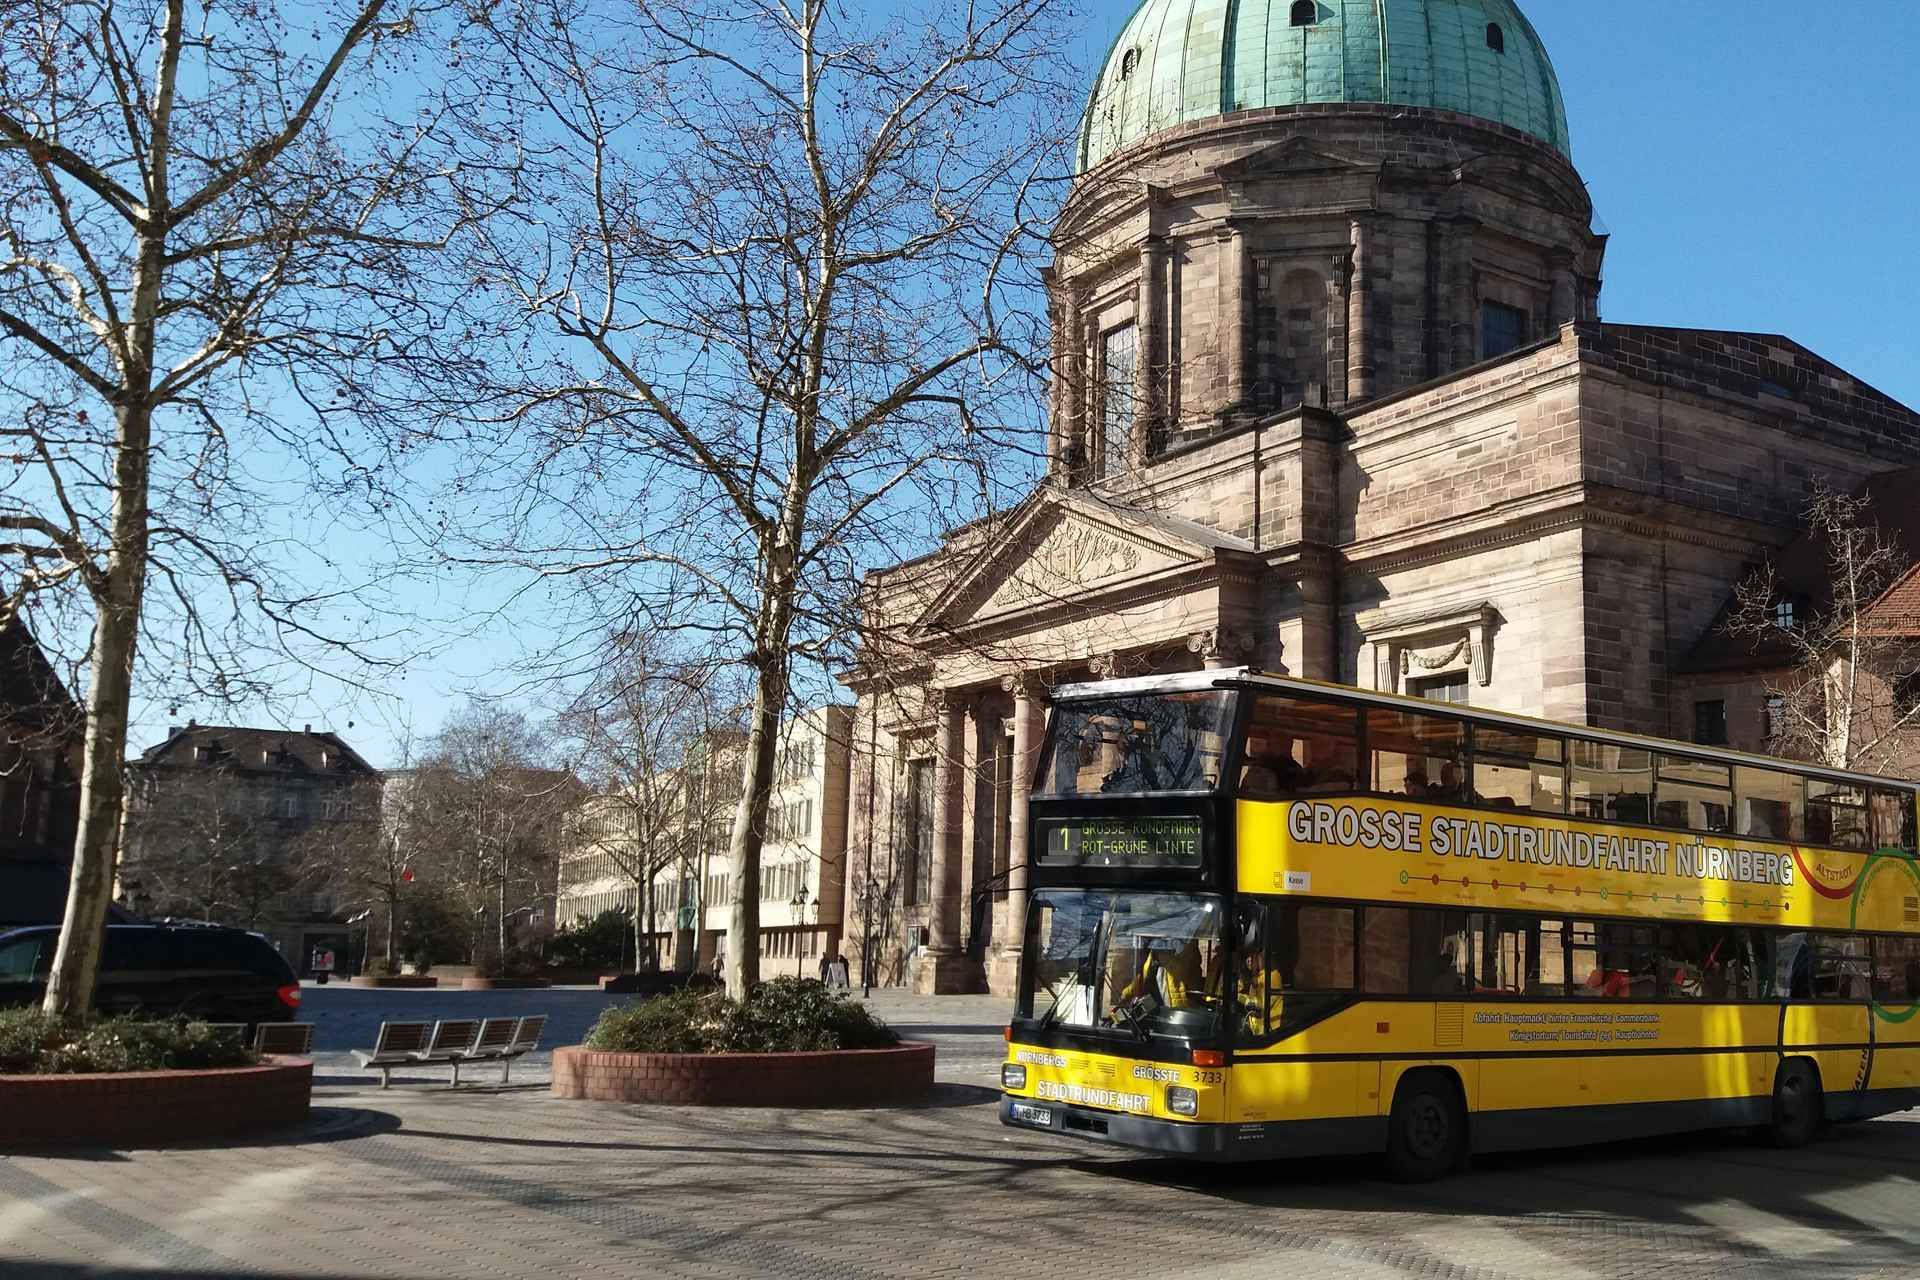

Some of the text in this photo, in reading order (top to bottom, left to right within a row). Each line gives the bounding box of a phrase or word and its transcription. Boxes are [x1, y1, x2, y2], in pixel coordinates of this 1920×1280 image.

[1081, 820, 1126, 835] GROSSE
[1060, 827, 1069, 850] 1
[1155, 840, 1195, 854] LINIE
[1287, 800, 1794, 887] GROSSE STADTRUNDFAHRT NÜRNBERG
[1192, 1071, 1222, 1084] 3733
[1037, 1080, 1151, 1112] STADTRUNDFAHRT
